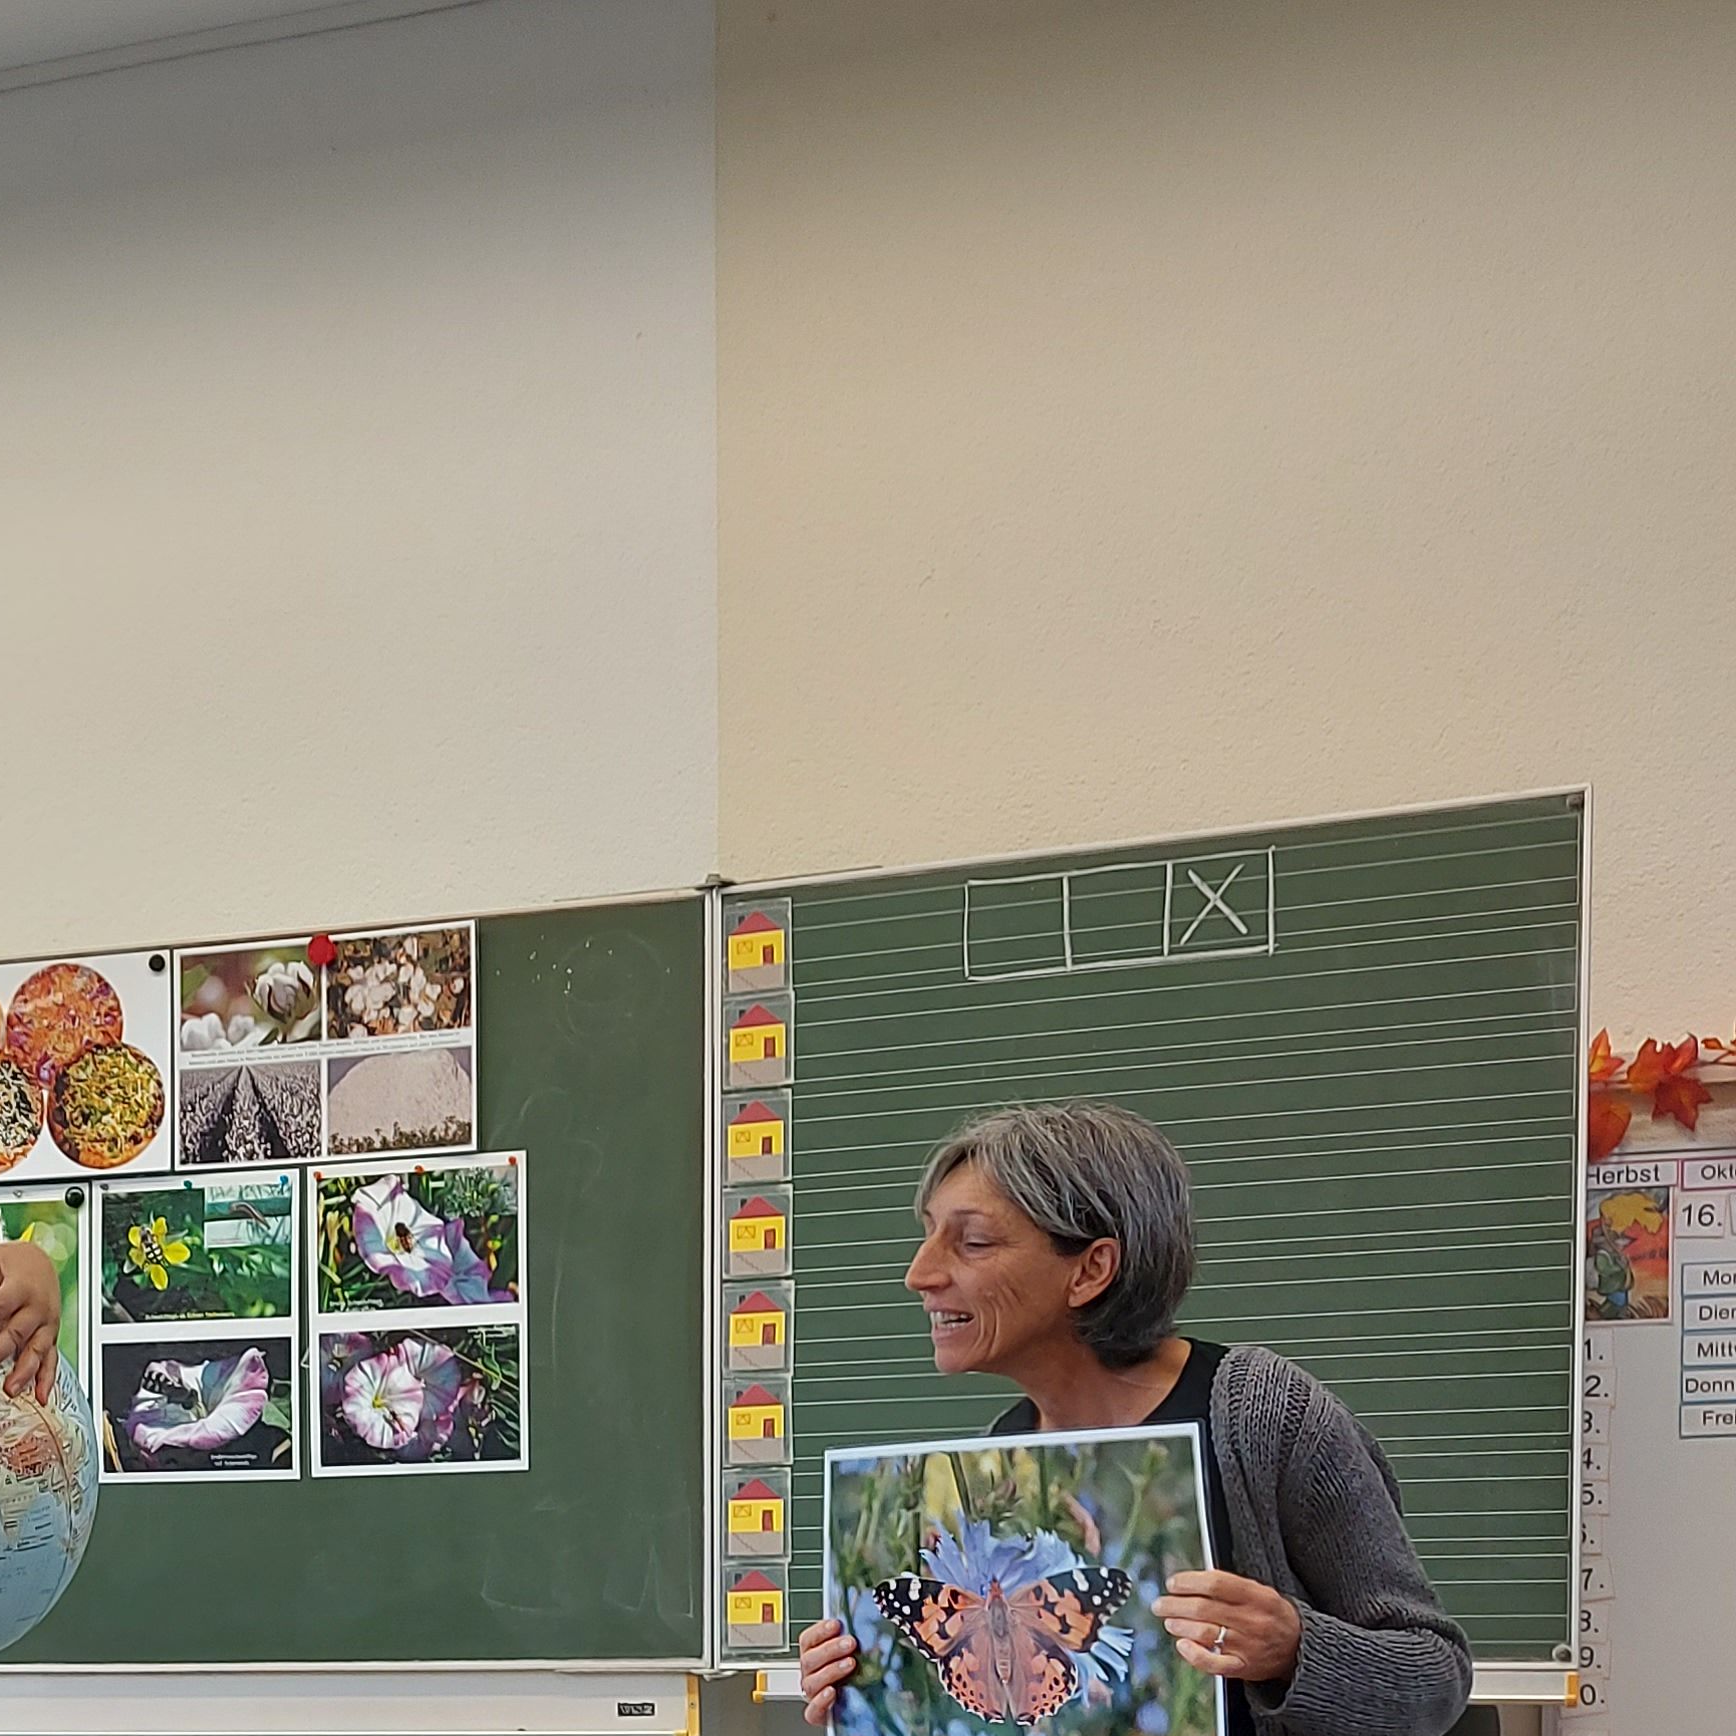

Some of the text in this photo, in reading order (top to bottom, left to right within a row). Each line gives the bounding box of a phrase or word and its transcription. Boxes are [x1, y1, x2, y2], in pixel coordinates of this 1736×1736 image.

[1587, 1163, 1661, 1185] Herbst
[1681, 1202, 1723, 1229] 16.
[1696, 1339, 1736, 1359] Mitt
[1584, 1376, 1610, 1399] 2.
[1580, 1567, 1606, 1591] 7.
[1579, 1683, 1606, 1707] 0.
